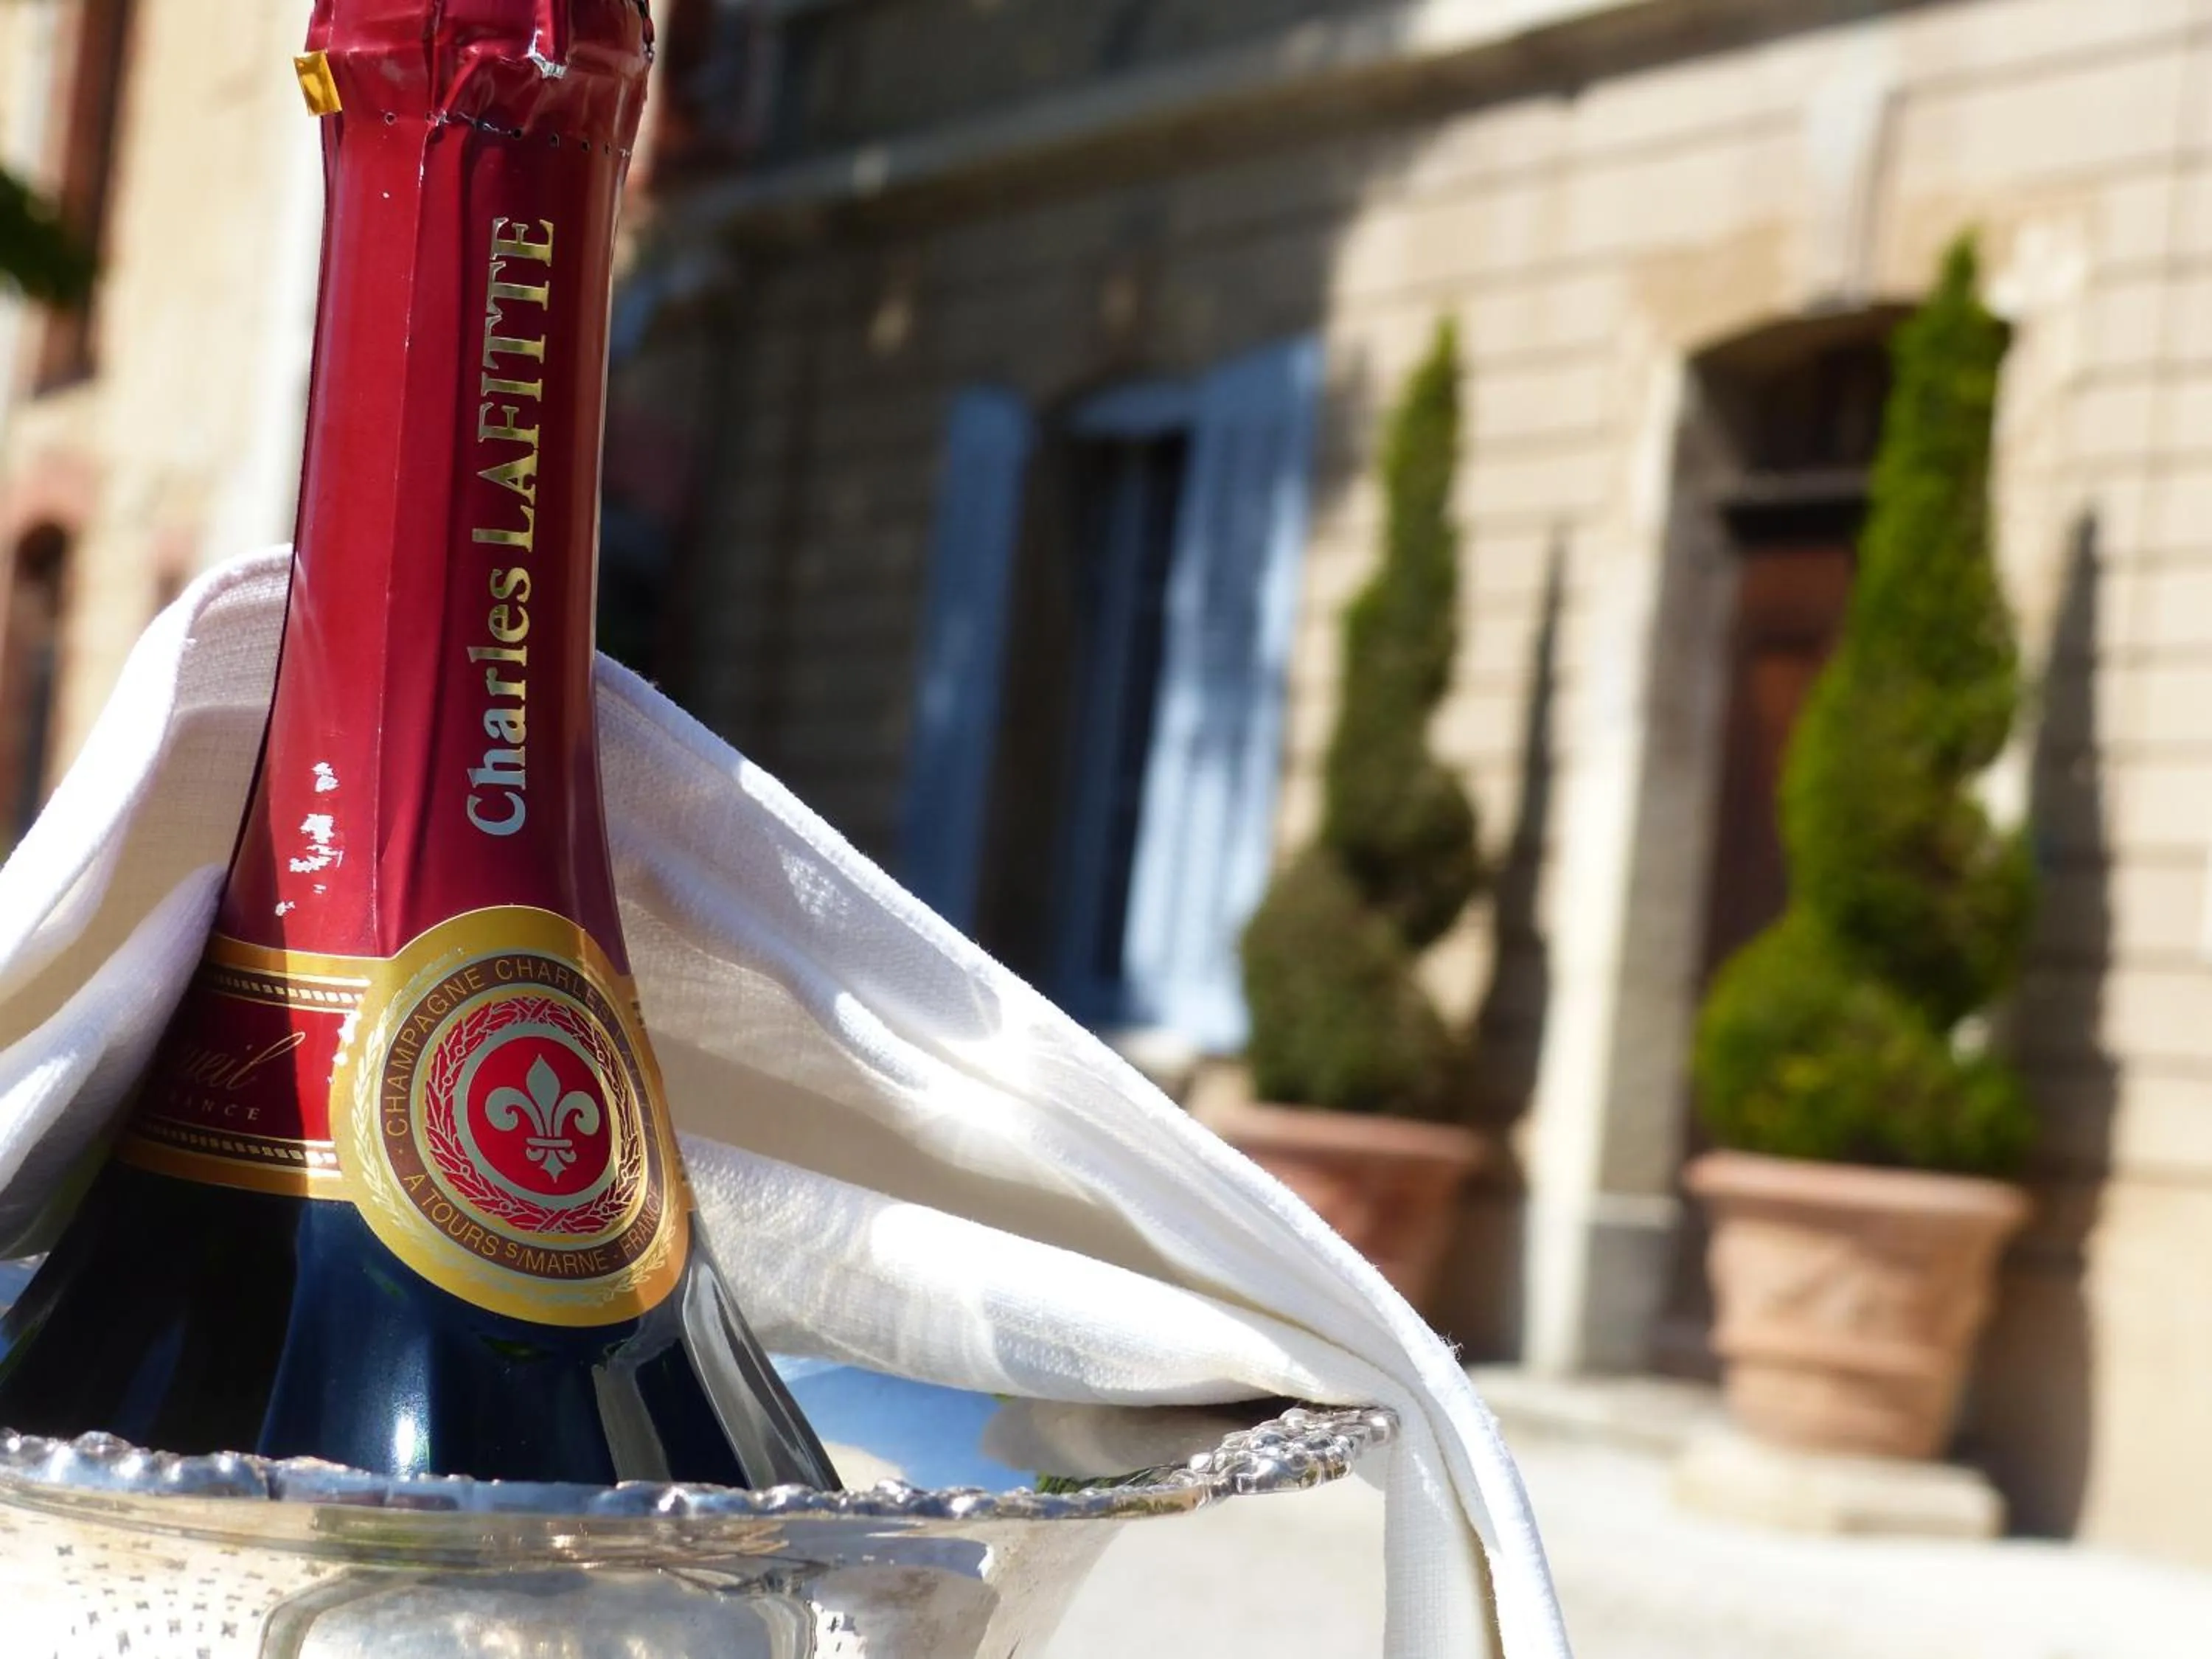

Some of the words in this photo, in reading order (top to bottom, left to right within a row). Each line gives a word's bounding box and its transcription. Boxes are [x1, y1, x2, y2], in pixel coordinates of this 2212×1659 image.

[473, 218, 554, 552] LAFITTE
[467, 568, 531, 836] Charles
[386, 965, 484, 1135] CHAMPAGNE
[496, 959, 610, 1020] CHARLES
[404, 1172, 425, 1194] A
[421, 1192, 499, 1256] TOURS
[624, 1186, 661, 1258] FRANCE
